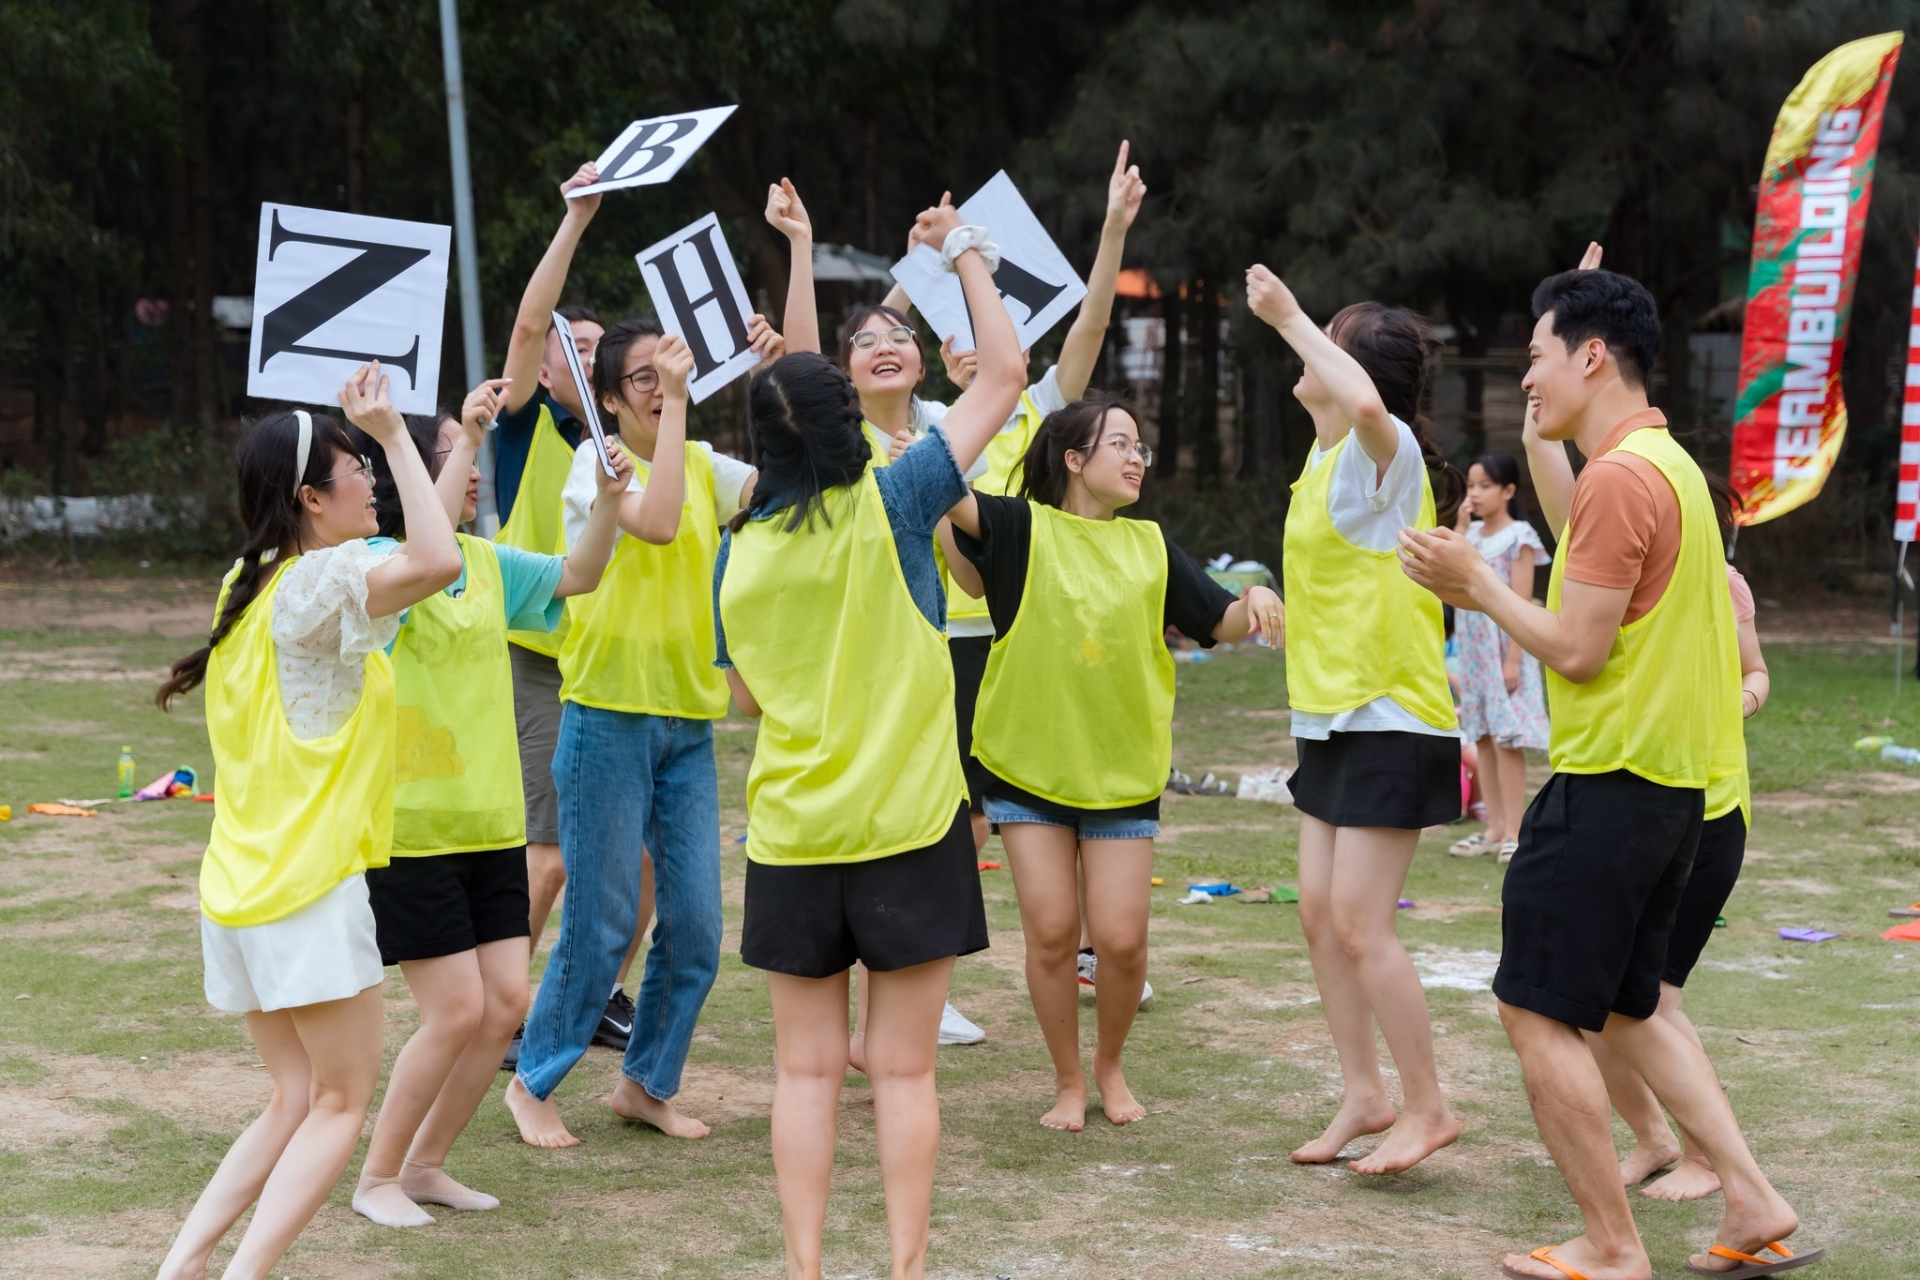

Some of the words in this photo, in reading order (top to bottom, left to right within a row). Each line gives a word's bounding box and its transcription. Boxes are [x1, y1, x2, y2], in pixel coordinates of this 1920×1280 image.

[596, 118, 699, 183] B
[259, 208, 431, 391] N
[644, 223, 752, 385] H
[1773, 109, 1862, 489] TEAMBUILDING
